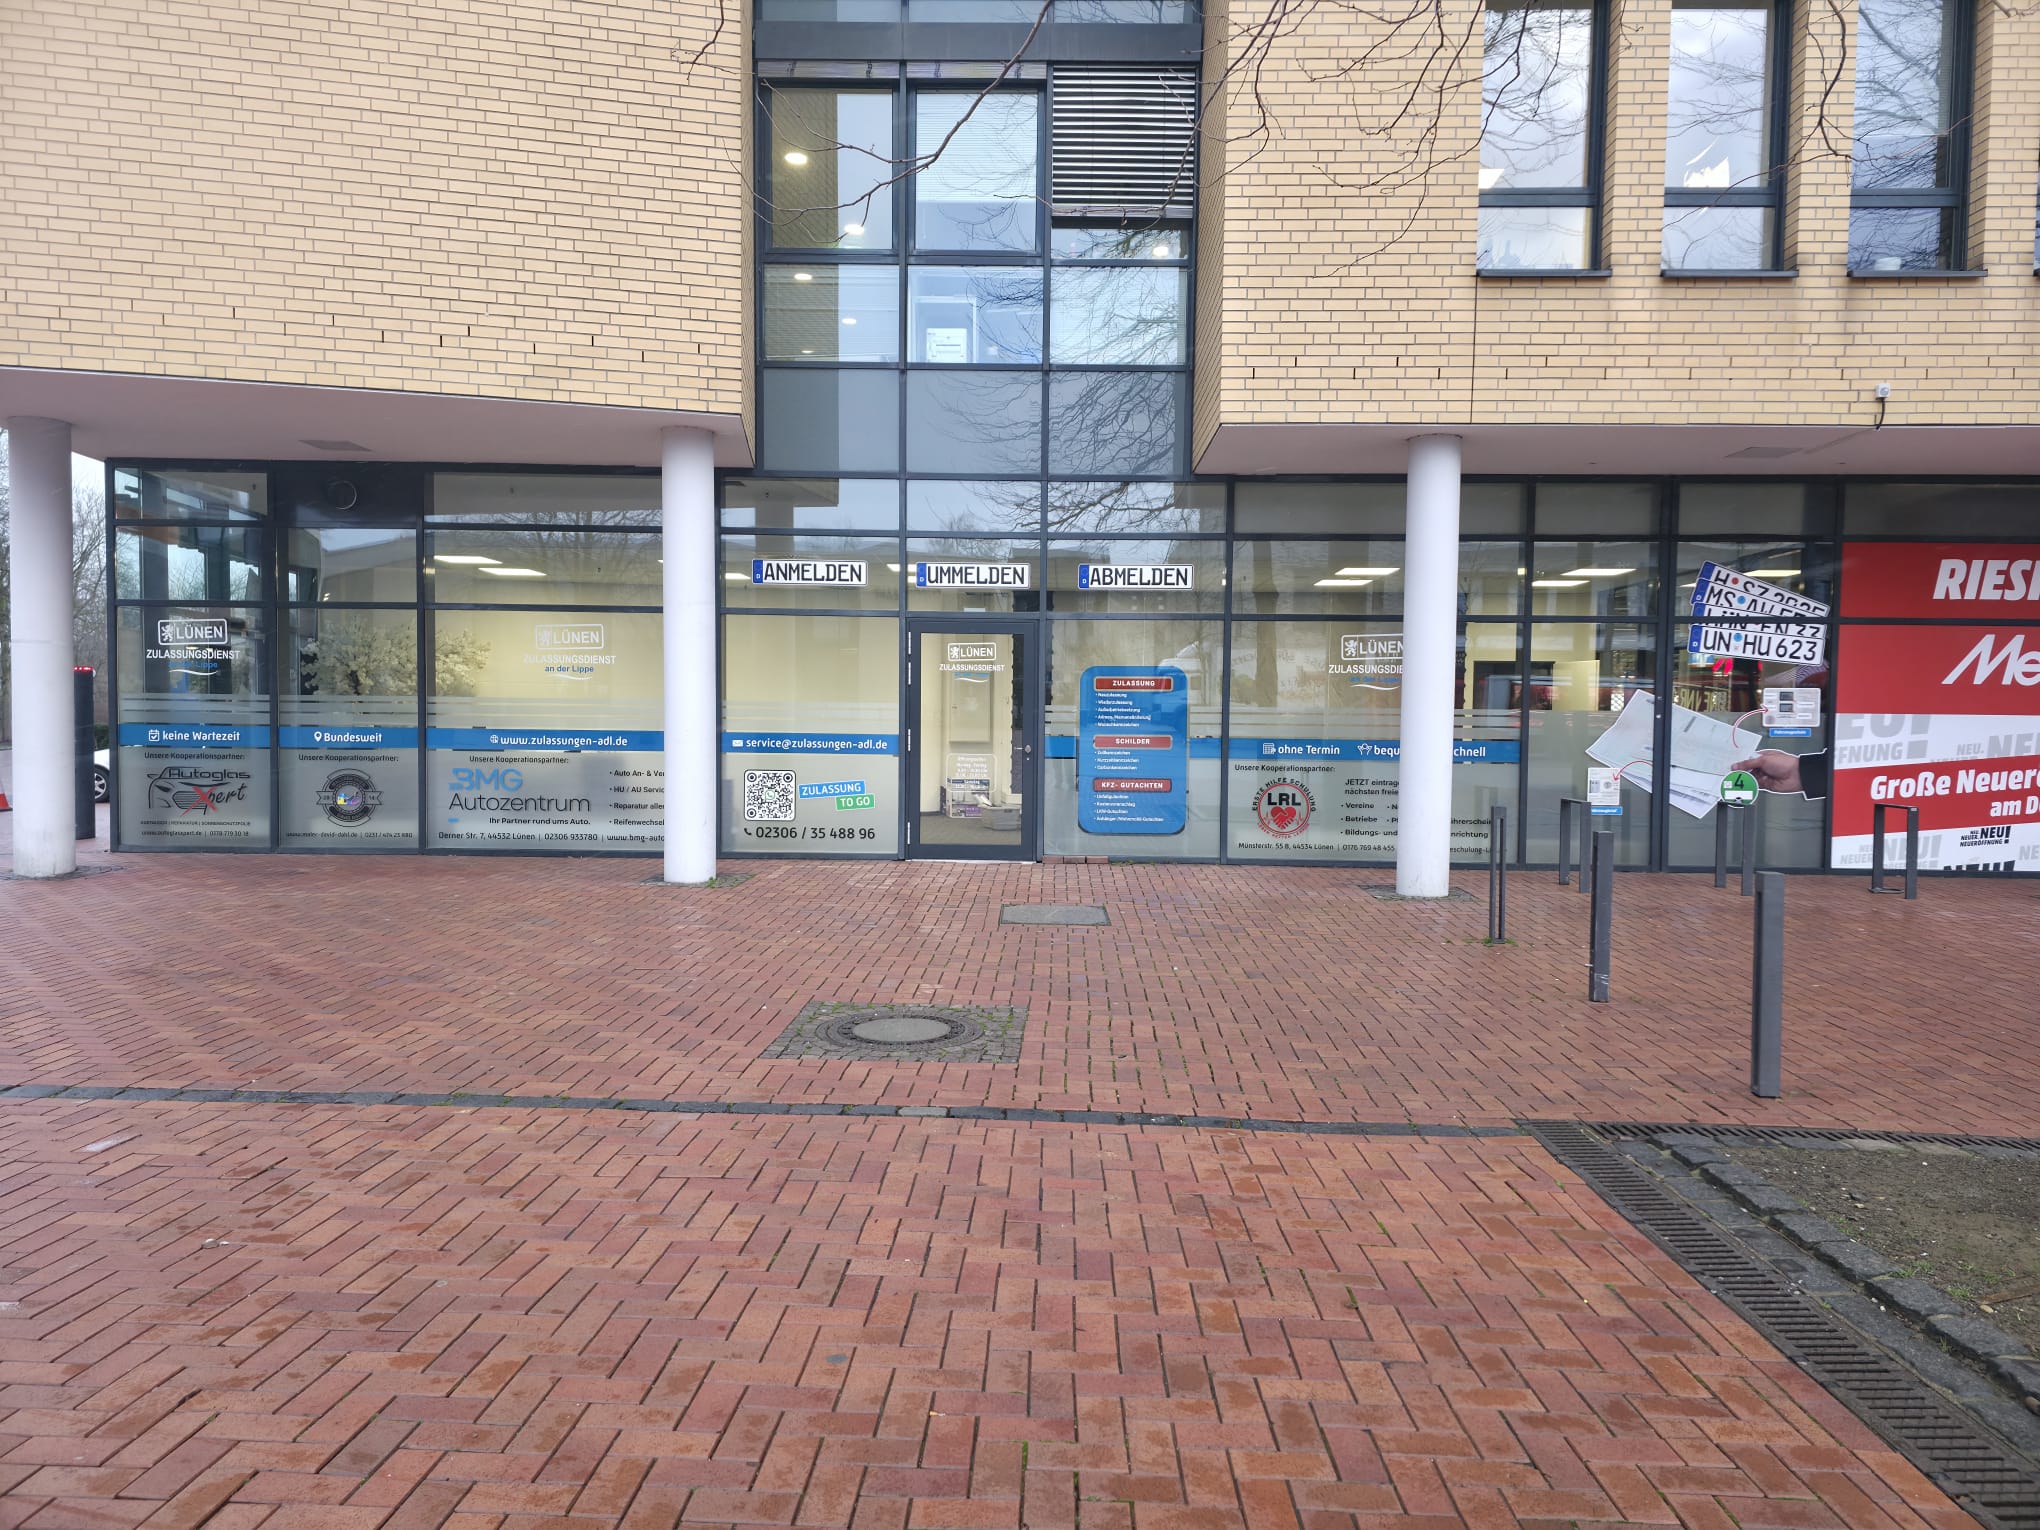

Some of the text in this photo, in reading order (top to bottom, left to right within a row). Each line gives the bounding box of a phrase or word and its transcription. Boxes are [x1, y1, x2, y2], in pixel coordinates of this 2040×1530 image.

[764, 562, 862, 582] ANMELDEN
[927, 565, 1025, 585] UMMELDEN
[1089, 566, 1188, 586] ABMELDEN
[176, 624, 223, 640] LÜNEN
[552, 628, 599, 644] LÜNEN
[960, 646, 993, 657] LÜNEN
[1704, 630, 1732, 652] UN
[1742, 634, 1771, 656] HU
[1775, 638, 1817, 661] 623
[146, 650, 240, 660] ZULASSUNGSDIENST
[523, 655, 616, 664] ZULASSUNGSDIENST
[556, 664, 569, 672] der
[572, 665, 594, 674] Lippe
[162, 731, 240, 741] keine Wartezeit
[324, 732, 382, 742] Bundesweit
[500, 735, 628, 747] www.zulassungen-adl.de
[746, 738, 887, 751] service@zulassungen-adl.de
[1278, 745, 1340, 755] ohne Termin
[496, 756, 568, 764] Kooperationspartner:
[1836, 742, 1903, 764] FNUNG
[169, 768, 251, 782] Autoglas
[452, 767, 523, 791] BMG
[1734, 774, 1744, 789] 4
[801, 782, 861, 796] ZULASSUNG
[1870, 772, 1951, 800] Große
[840, 796, 870, 808] TO GO
[1252, 778, 1316, 812] ERSTE HILFE SCHULUNG
[1268, 793, 1301, 806] LRL
[449, 793, 590, 812] Autozentrum
[1990, 796, 2040, 816] am D
[479, 832, 486, 841] 7,
[512, 832, 535, 840] Lünen
[755, 827, 797, 839] 02306
[810, 828, 825, 839] 35
[829, 828, 854, 839] 488
[859, 828, 875, 840] 96
[1980, 826, 2012, 844] NEU!
[1960, 839, 2003, 847] NEUERÖFFNUNG
